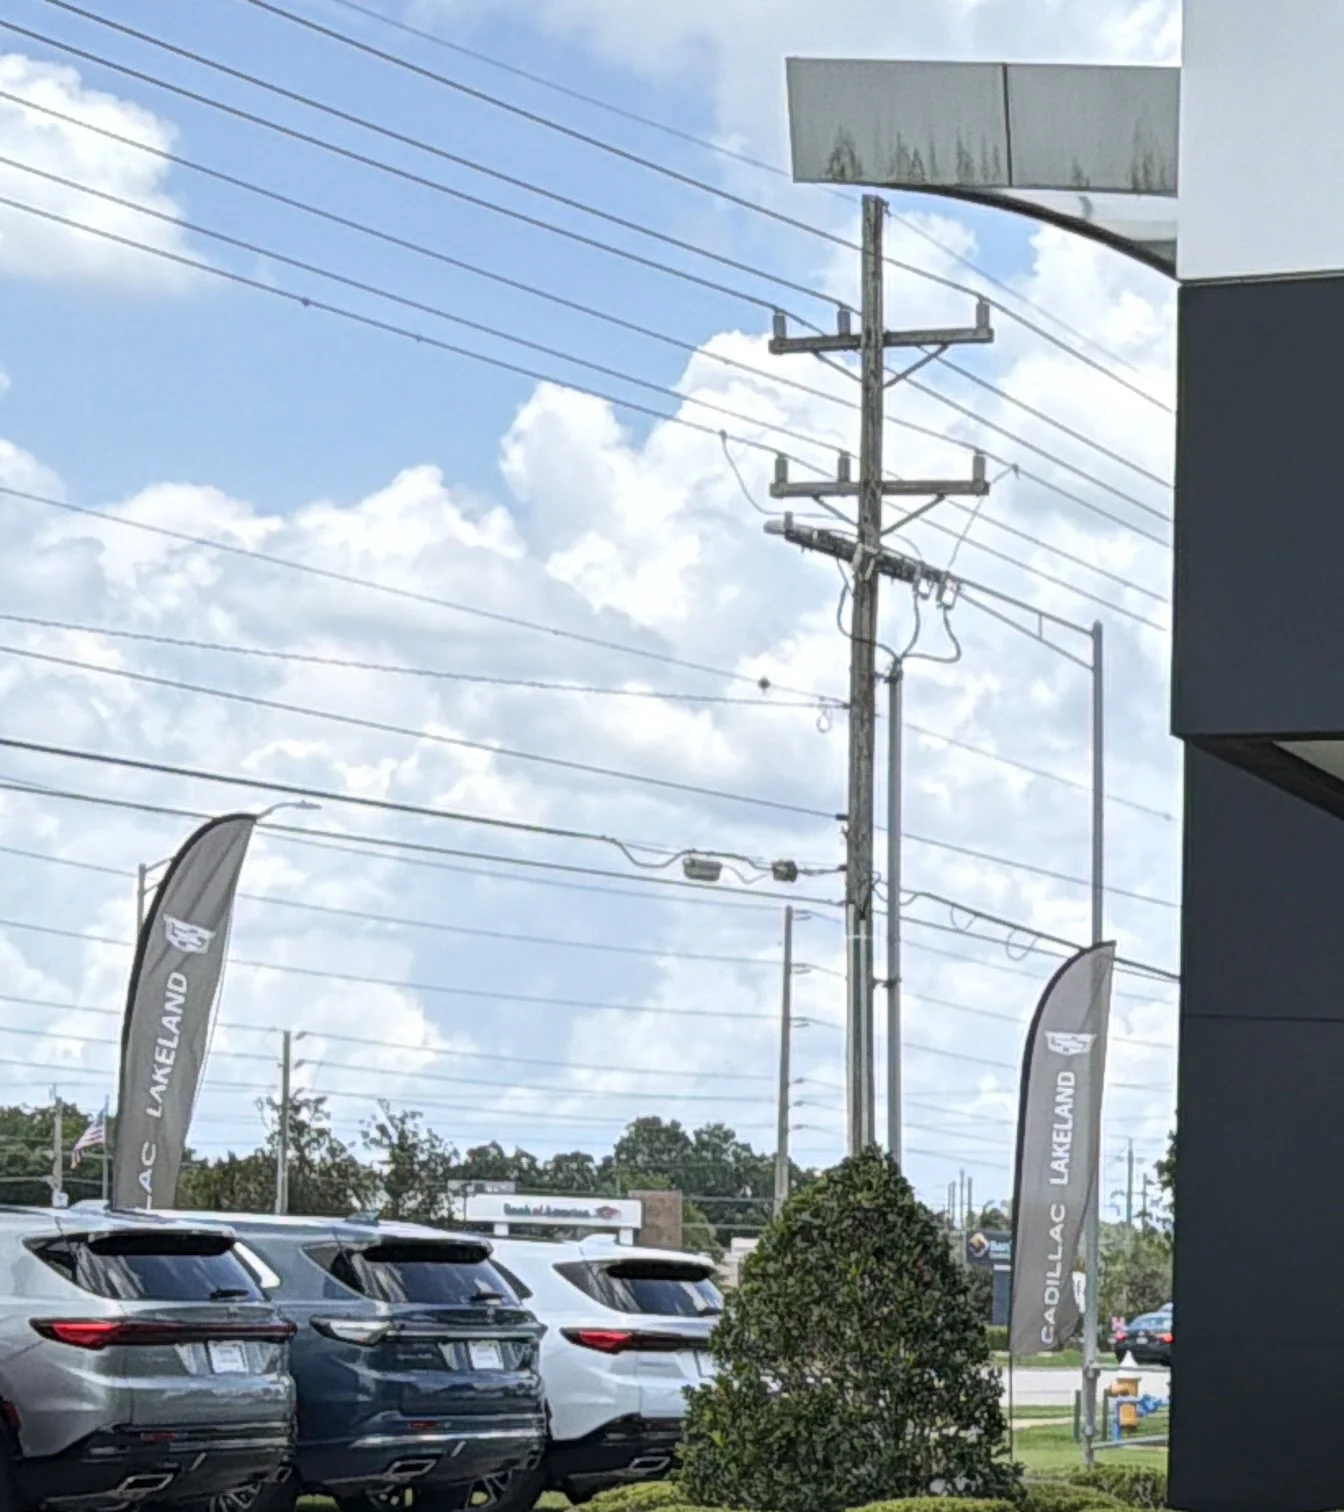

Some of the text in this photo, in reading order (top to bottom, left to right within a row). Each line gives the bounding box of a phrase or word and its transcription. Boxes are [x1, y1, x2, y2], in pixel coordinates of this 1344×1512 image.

[146, 971, 188, 1119] LAKELAND
[1041, 1071, 1076, 1345] CADILLAC LAKELAND
